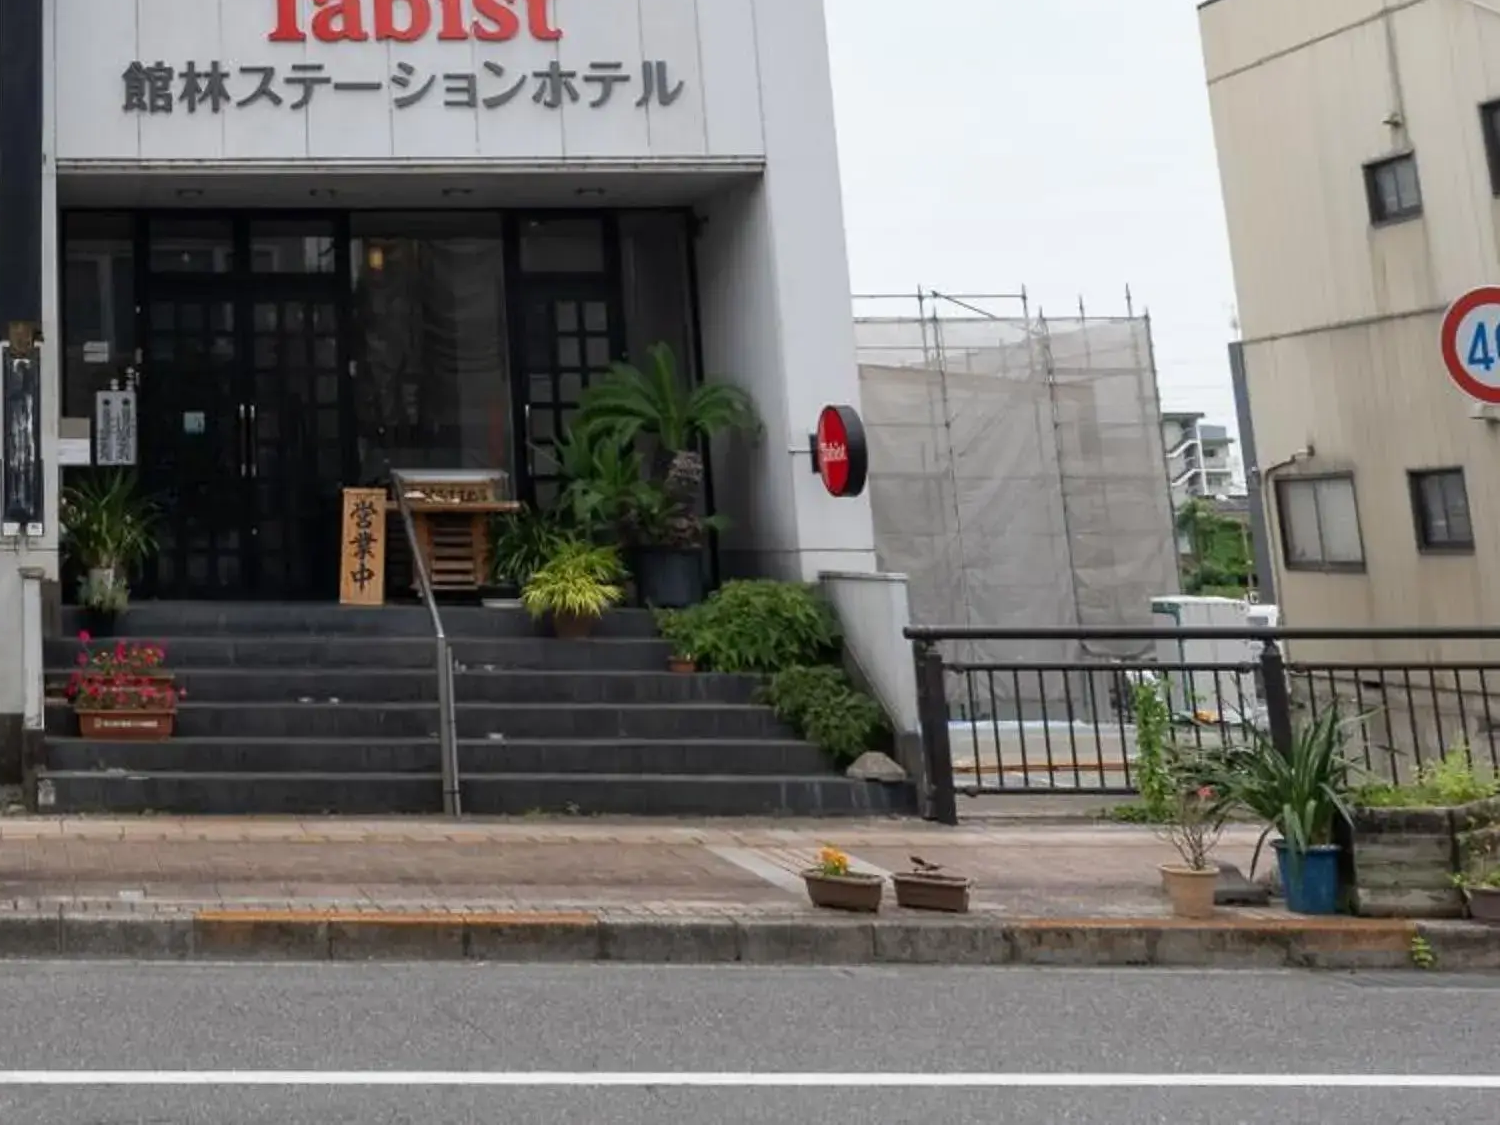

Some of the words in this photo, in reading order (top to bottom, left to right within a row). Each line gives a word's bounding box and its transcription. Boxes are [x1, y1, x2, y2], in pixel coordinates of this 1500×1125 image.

[122, 61, 684, 115] 館林ステーションホテル
[1467, 321, 1500, 372] 4
[349, 499, 378, 594] 営業中
